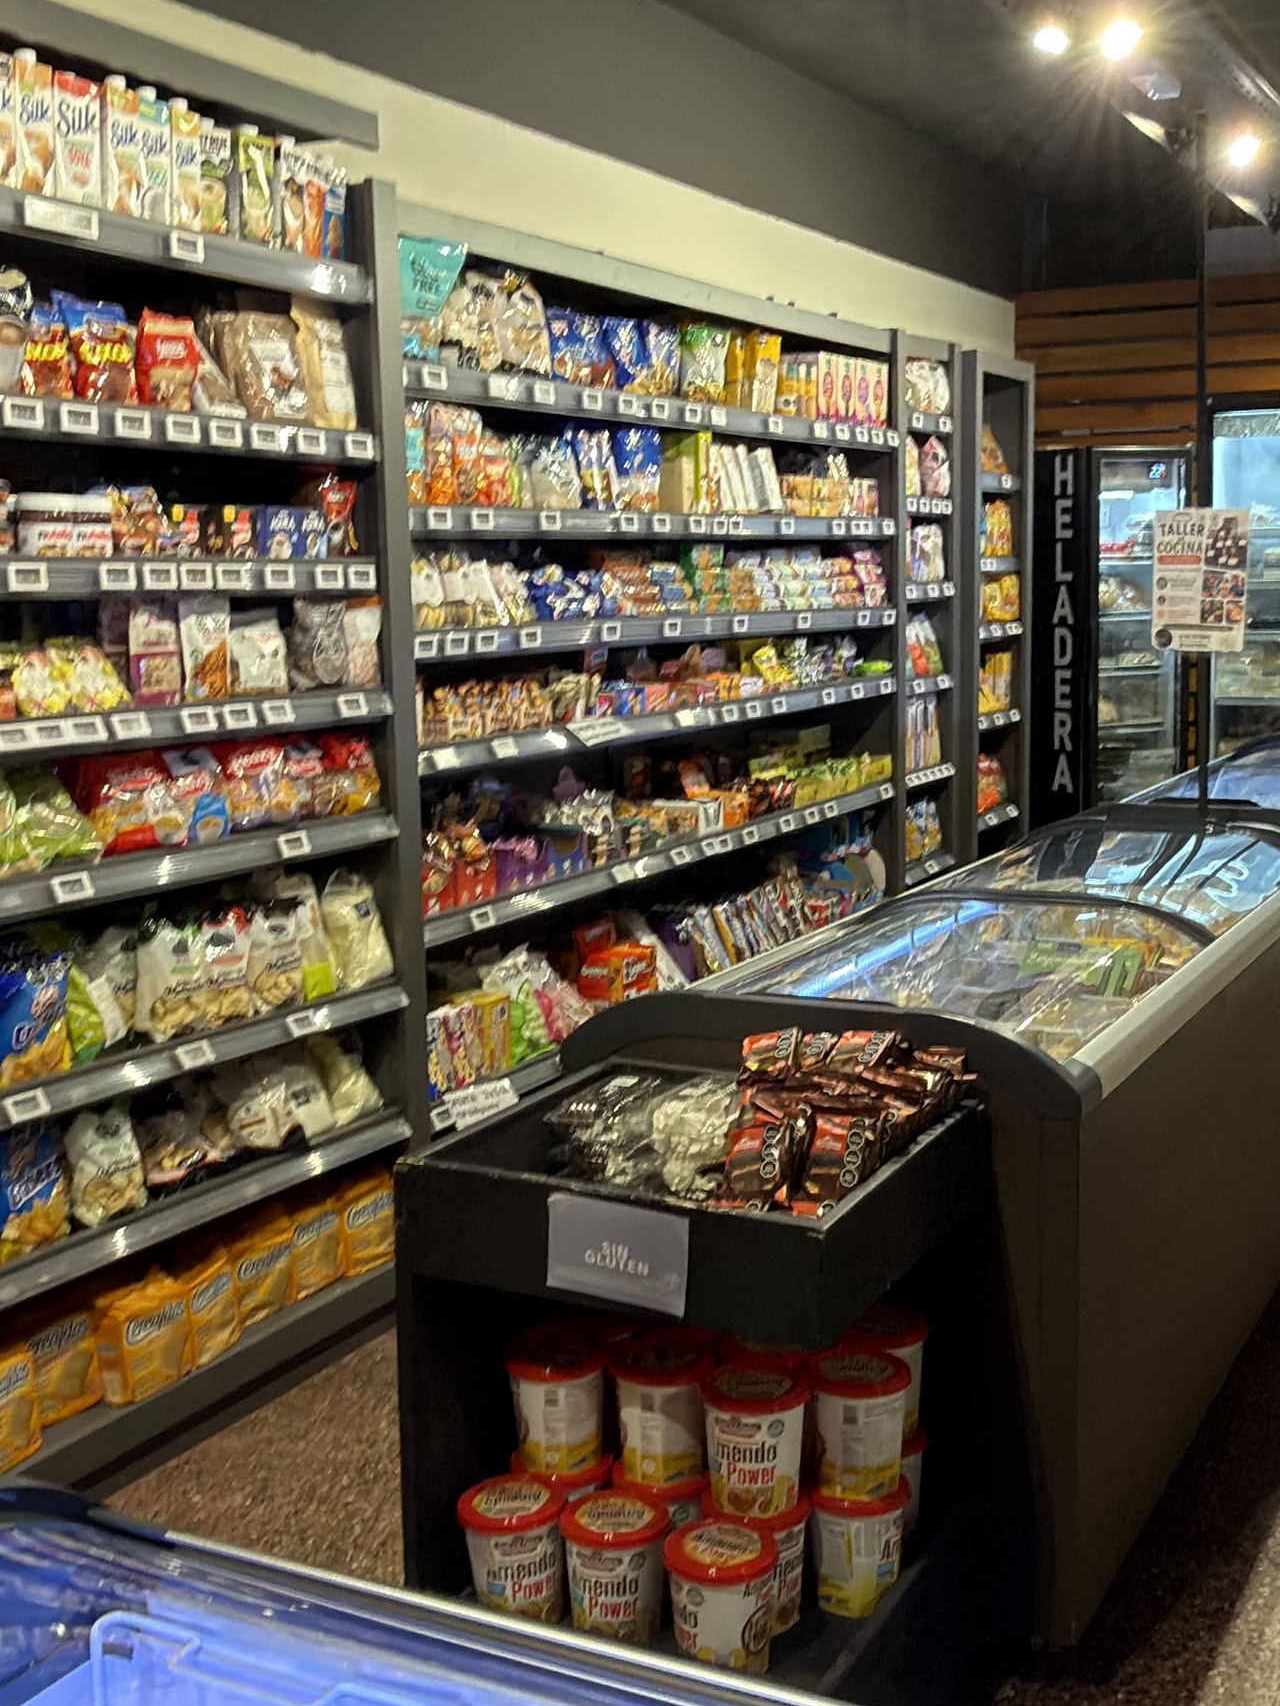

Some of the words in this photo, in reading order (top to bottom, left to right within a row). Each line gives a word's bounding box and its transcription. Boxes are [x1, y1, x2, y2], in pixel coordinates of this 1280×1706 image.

[56, 99, 96, 137] Silk
[1159, 523, 1204, 537] TALLER
[1157, 541, 1202, 554] COCINA
[1053, 455, 1075, 794] HELADERA
[727, 1462, 777, 1486] Power
[589, 1596, 639, 1619] Power
